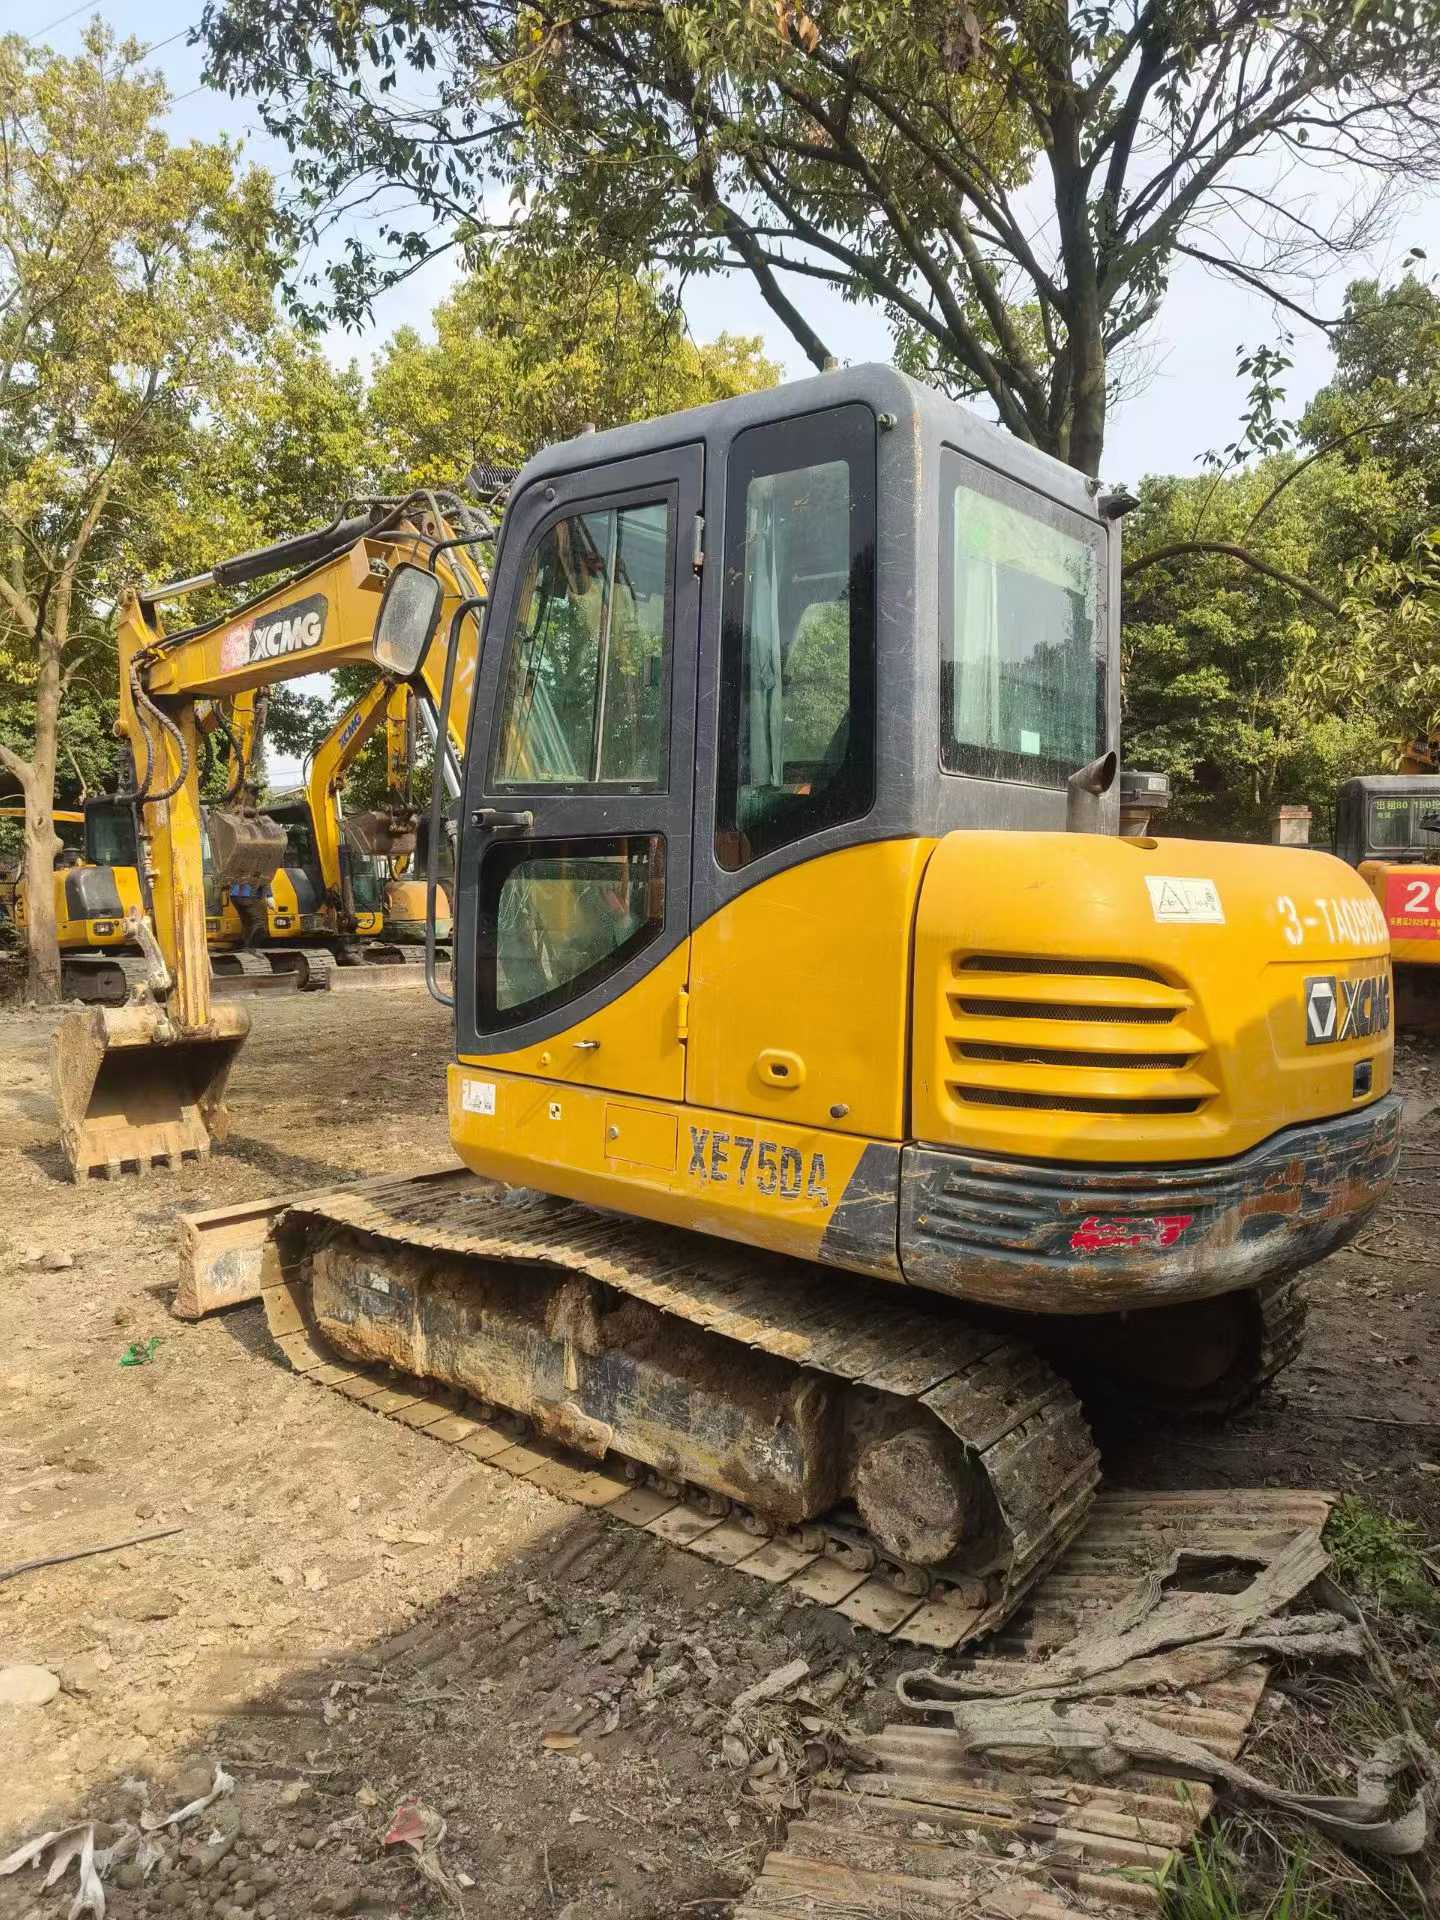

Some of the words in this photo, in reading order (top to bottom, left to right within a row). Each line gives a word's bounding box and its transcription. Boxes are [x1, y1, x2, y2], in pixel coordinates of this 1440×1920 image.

[250, 612, 322, 662] XCMG
[339, 711, 362, 745] XCMG
[1404, 880, 1440, 913] 2
[1336, 974, 1390, 1041] XCMG
[688, 1126, 829, 1208] XE75DA
